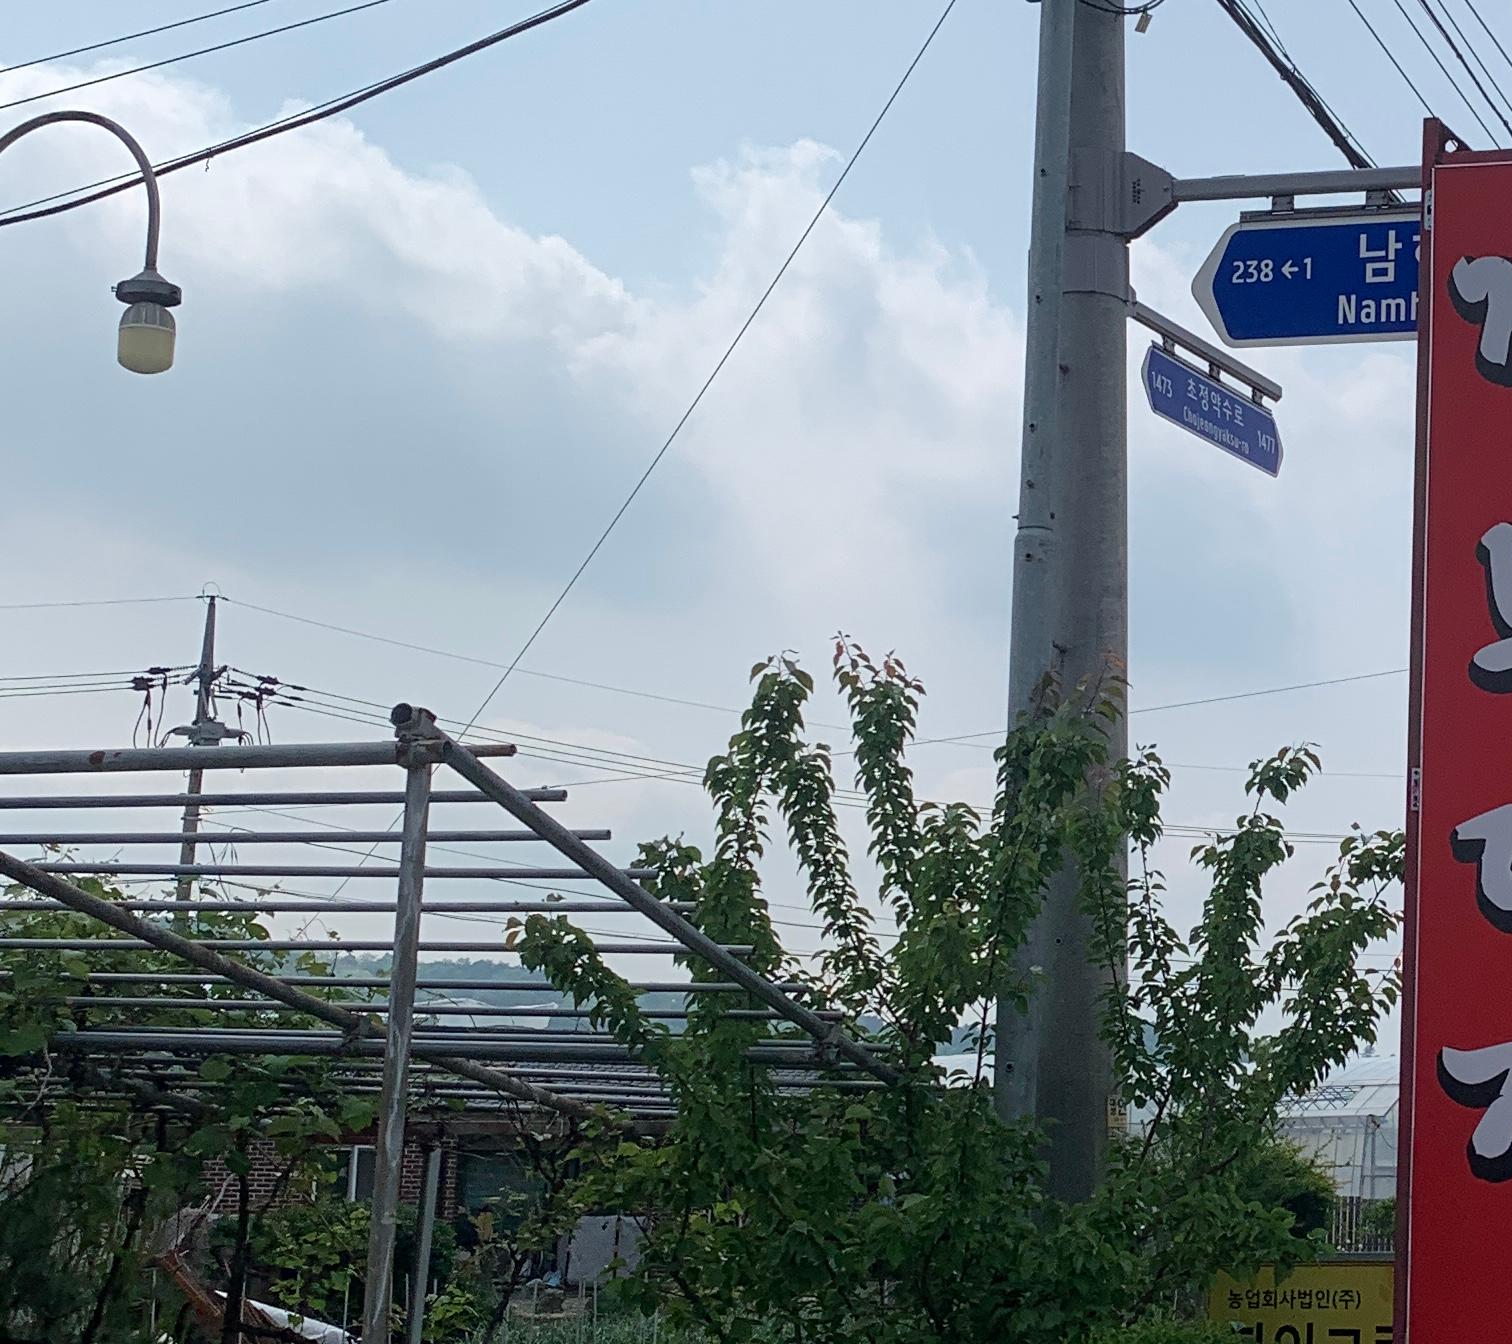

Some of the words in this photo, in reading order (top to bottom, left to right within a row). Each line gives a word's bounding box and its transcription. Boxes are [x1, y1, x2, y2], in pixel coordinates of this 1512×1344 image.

[1231, 259, 1274, 284] 238
[1358, 228, 1421, 284] 남
[1151, 370, 1173, 398] 1473
[1186, 377, 1245, 427] 초정약수로
[1256, 430, 1276, 455] 1477
[1227, 1289, 1362, 1310] 농업회사법인(주)
